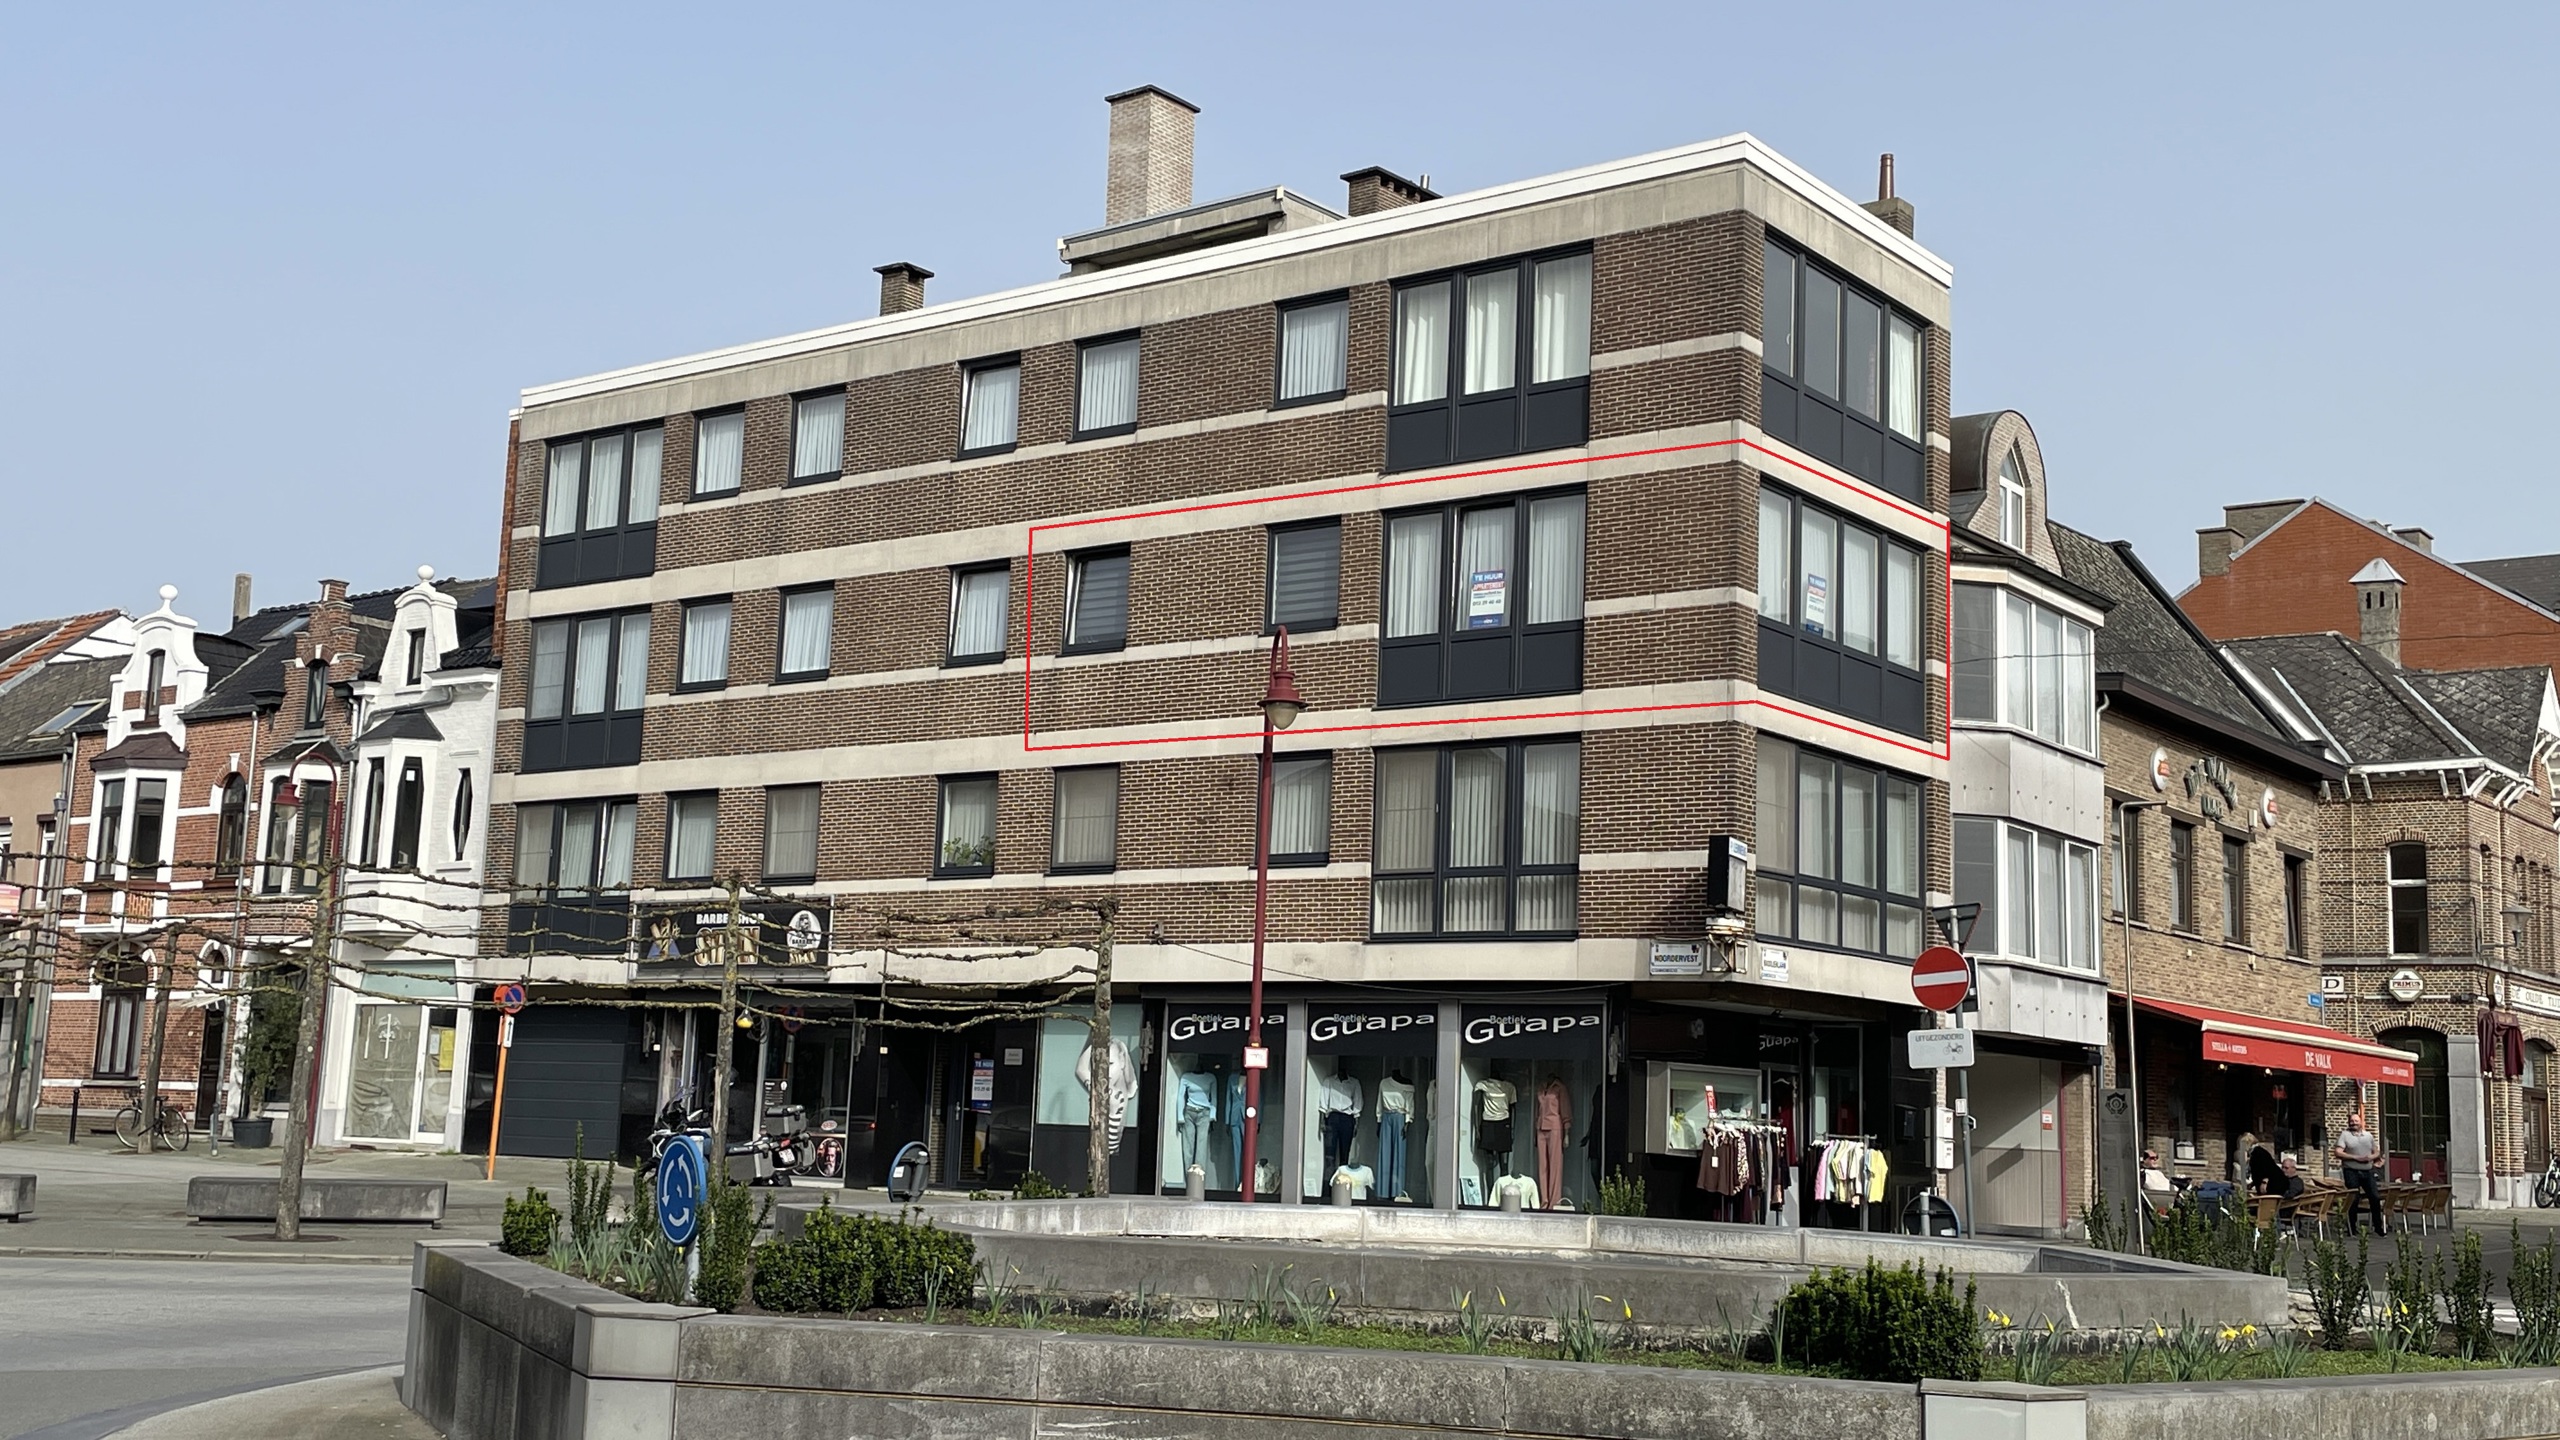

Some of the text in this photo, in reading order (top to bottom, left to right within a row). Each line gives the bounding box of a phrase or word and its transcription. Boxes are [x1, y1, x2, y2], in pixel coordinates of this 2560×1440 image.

[1310, 1014, 1434, 1042] Guapa
[1465, 1016, 1600, 1044] Guapa
[2305, 1052, 2332, 1069] DE VALK
